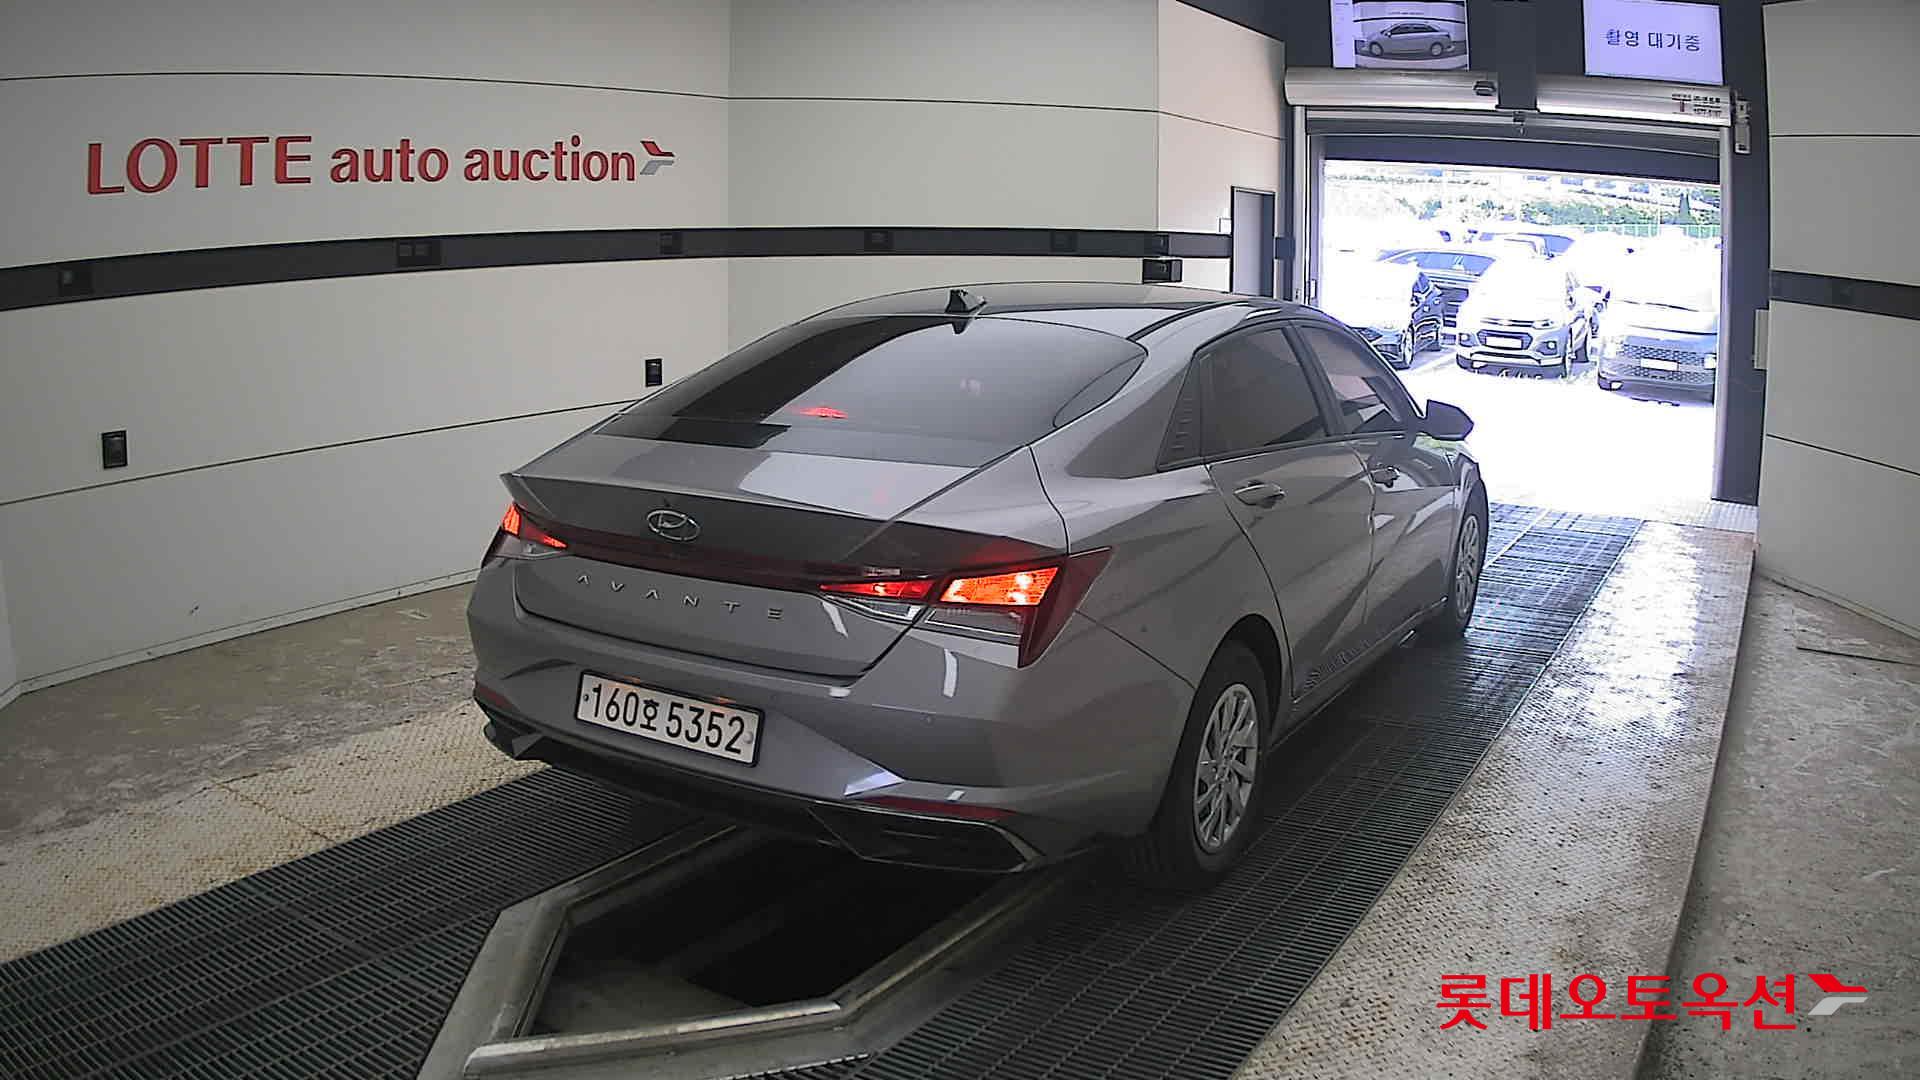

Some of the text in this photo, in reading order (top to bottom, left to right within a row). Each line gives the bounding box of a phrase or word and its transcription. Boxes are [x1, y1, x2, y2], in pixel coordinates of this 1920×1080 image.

[1648, 32, 1700, 51] 대기중
[87, 135, 635, 194] LOTTE auto auction
[577, 575, 783, 620] AVANTE
